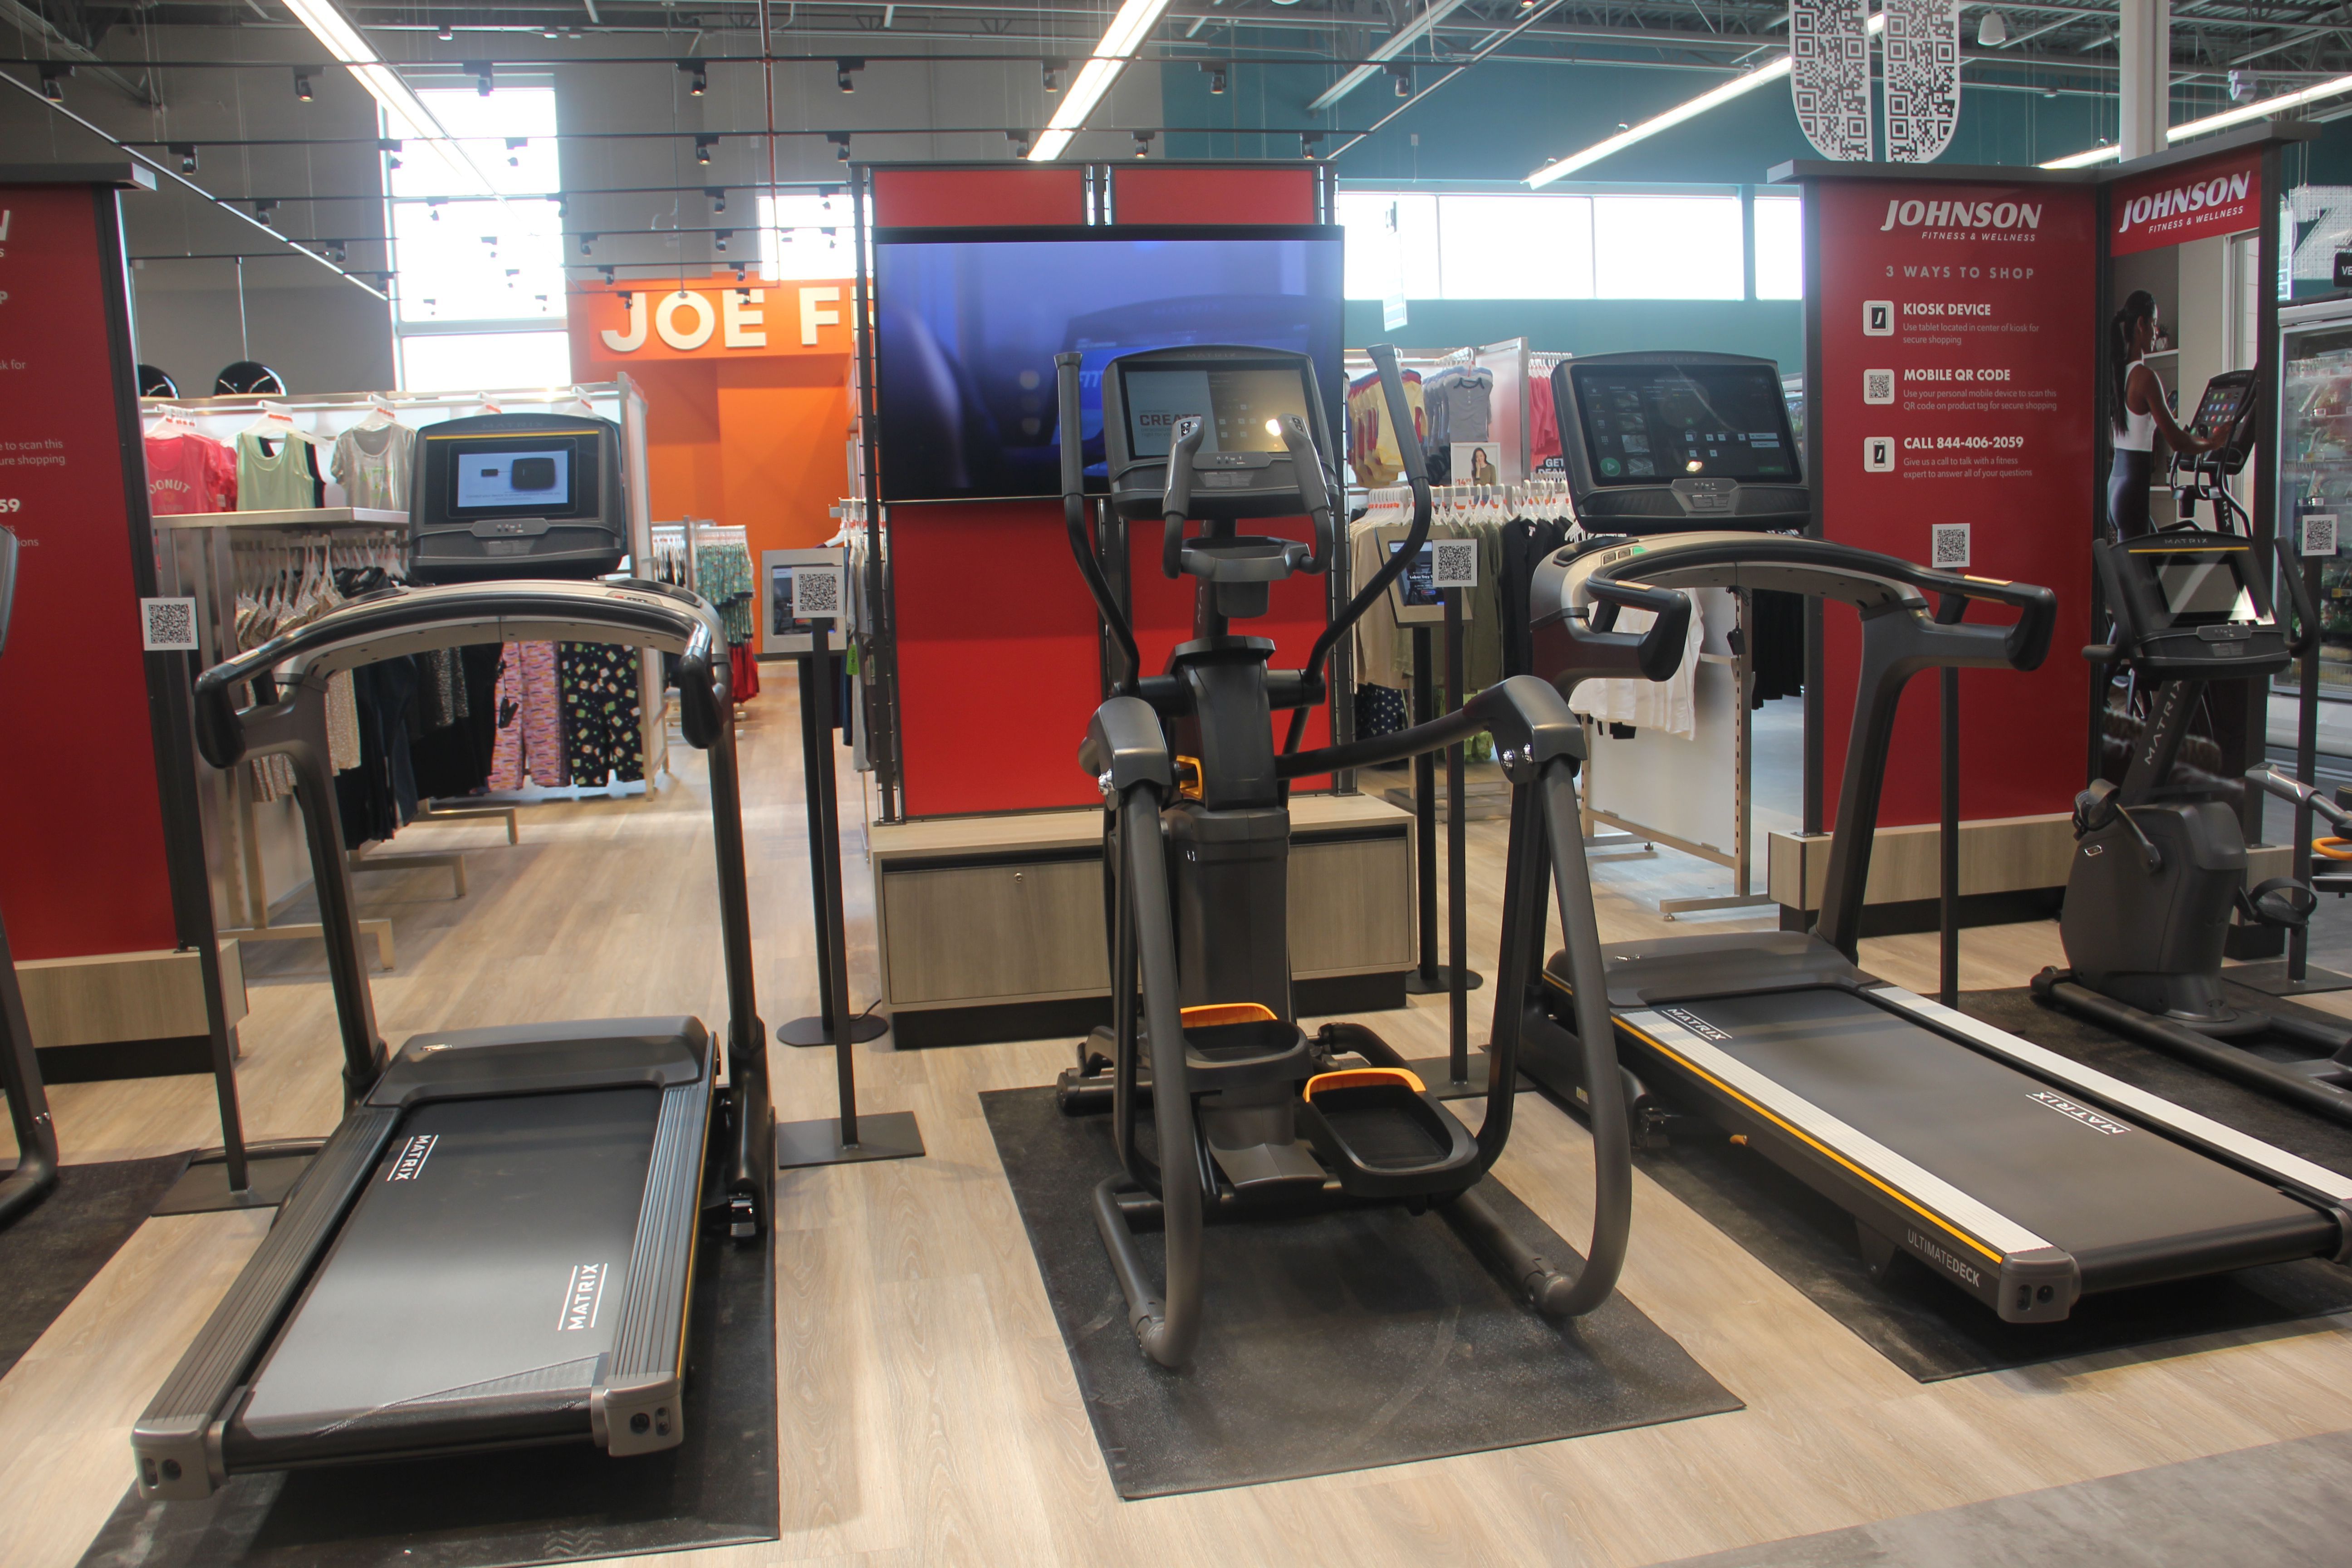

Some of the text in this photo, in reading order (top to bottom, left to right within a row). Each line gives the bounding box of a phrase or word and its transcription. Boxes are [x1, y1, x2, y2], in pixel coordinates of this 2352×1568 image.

[2118, 171, 2250, 233] JOHNSON
[1880, 200, 2042, 231] JOHNSON
[2148, 219, 2183, 234] FITNESS
[2195, 206, 2244, 223] WELLNESS
[1981, 233, 2035, 241] WELLNESS
[1886, 266, 2034, 279] 3 WAYS TO SHOP
[1903, 303, 1991, 315] KIOSK DEVICE
[601, 289, 767, 352] JOE
[2029, 323, 2039, 332] for
[1929, 335, 1961, 345] shopping
[11, 359, 26, 369] for
[1904, 369, 2010, 381] MOBILE QR CODE
[1903, 389, 1917, 397] Use
[1919, 391, 1935, 399] your
[1937, 389, 1967, 399] personal
[1969, 388, 1993, 397] mobile
[1994, 389, 2017, 397] device
[2044, 389, 2057, 397] this
[1903, 402, 1915, 411] QR
[1917, 401, 1935, 409] code
[1948, 401, 1975, 412] product
[1977, 402, 1988, 412] tag
[1990, 401, 1999, 409] for
[2025, 401, 2057, 411] shopping
[5, 442, 16, 450] to
[45, 439, 63, 448] this
[1904, 436, 2024, 449] CALL 844-406-2059
[18, 455, 65, 466] shopping
[1903, 457, 1920, 466] Give
[1937, 457, 1949, 466] call
[1960, 456, 1972, 465] talk
[1974, 456, 1989, 465] with
[1996, 456, 2018, 464] fitness
[1903, 471, 1926, 479] expert
[1964, 469, 1972, 477] all
[1974, 468, 1981, 476] of
[1999, 468, 2033, 478] questions
[2144, 680, 2182, 765] MATRIX
[1667, 1009, 1726, 1040] MATRIX
[2032, 1092, 2125, 1134] MATRIX
[394, 1135, 431, 1181] MATRIX
[1908, 1228, 1980, 1288] ULTIMATEDECK
[567, 1263, 599, 1330] MATRIX
